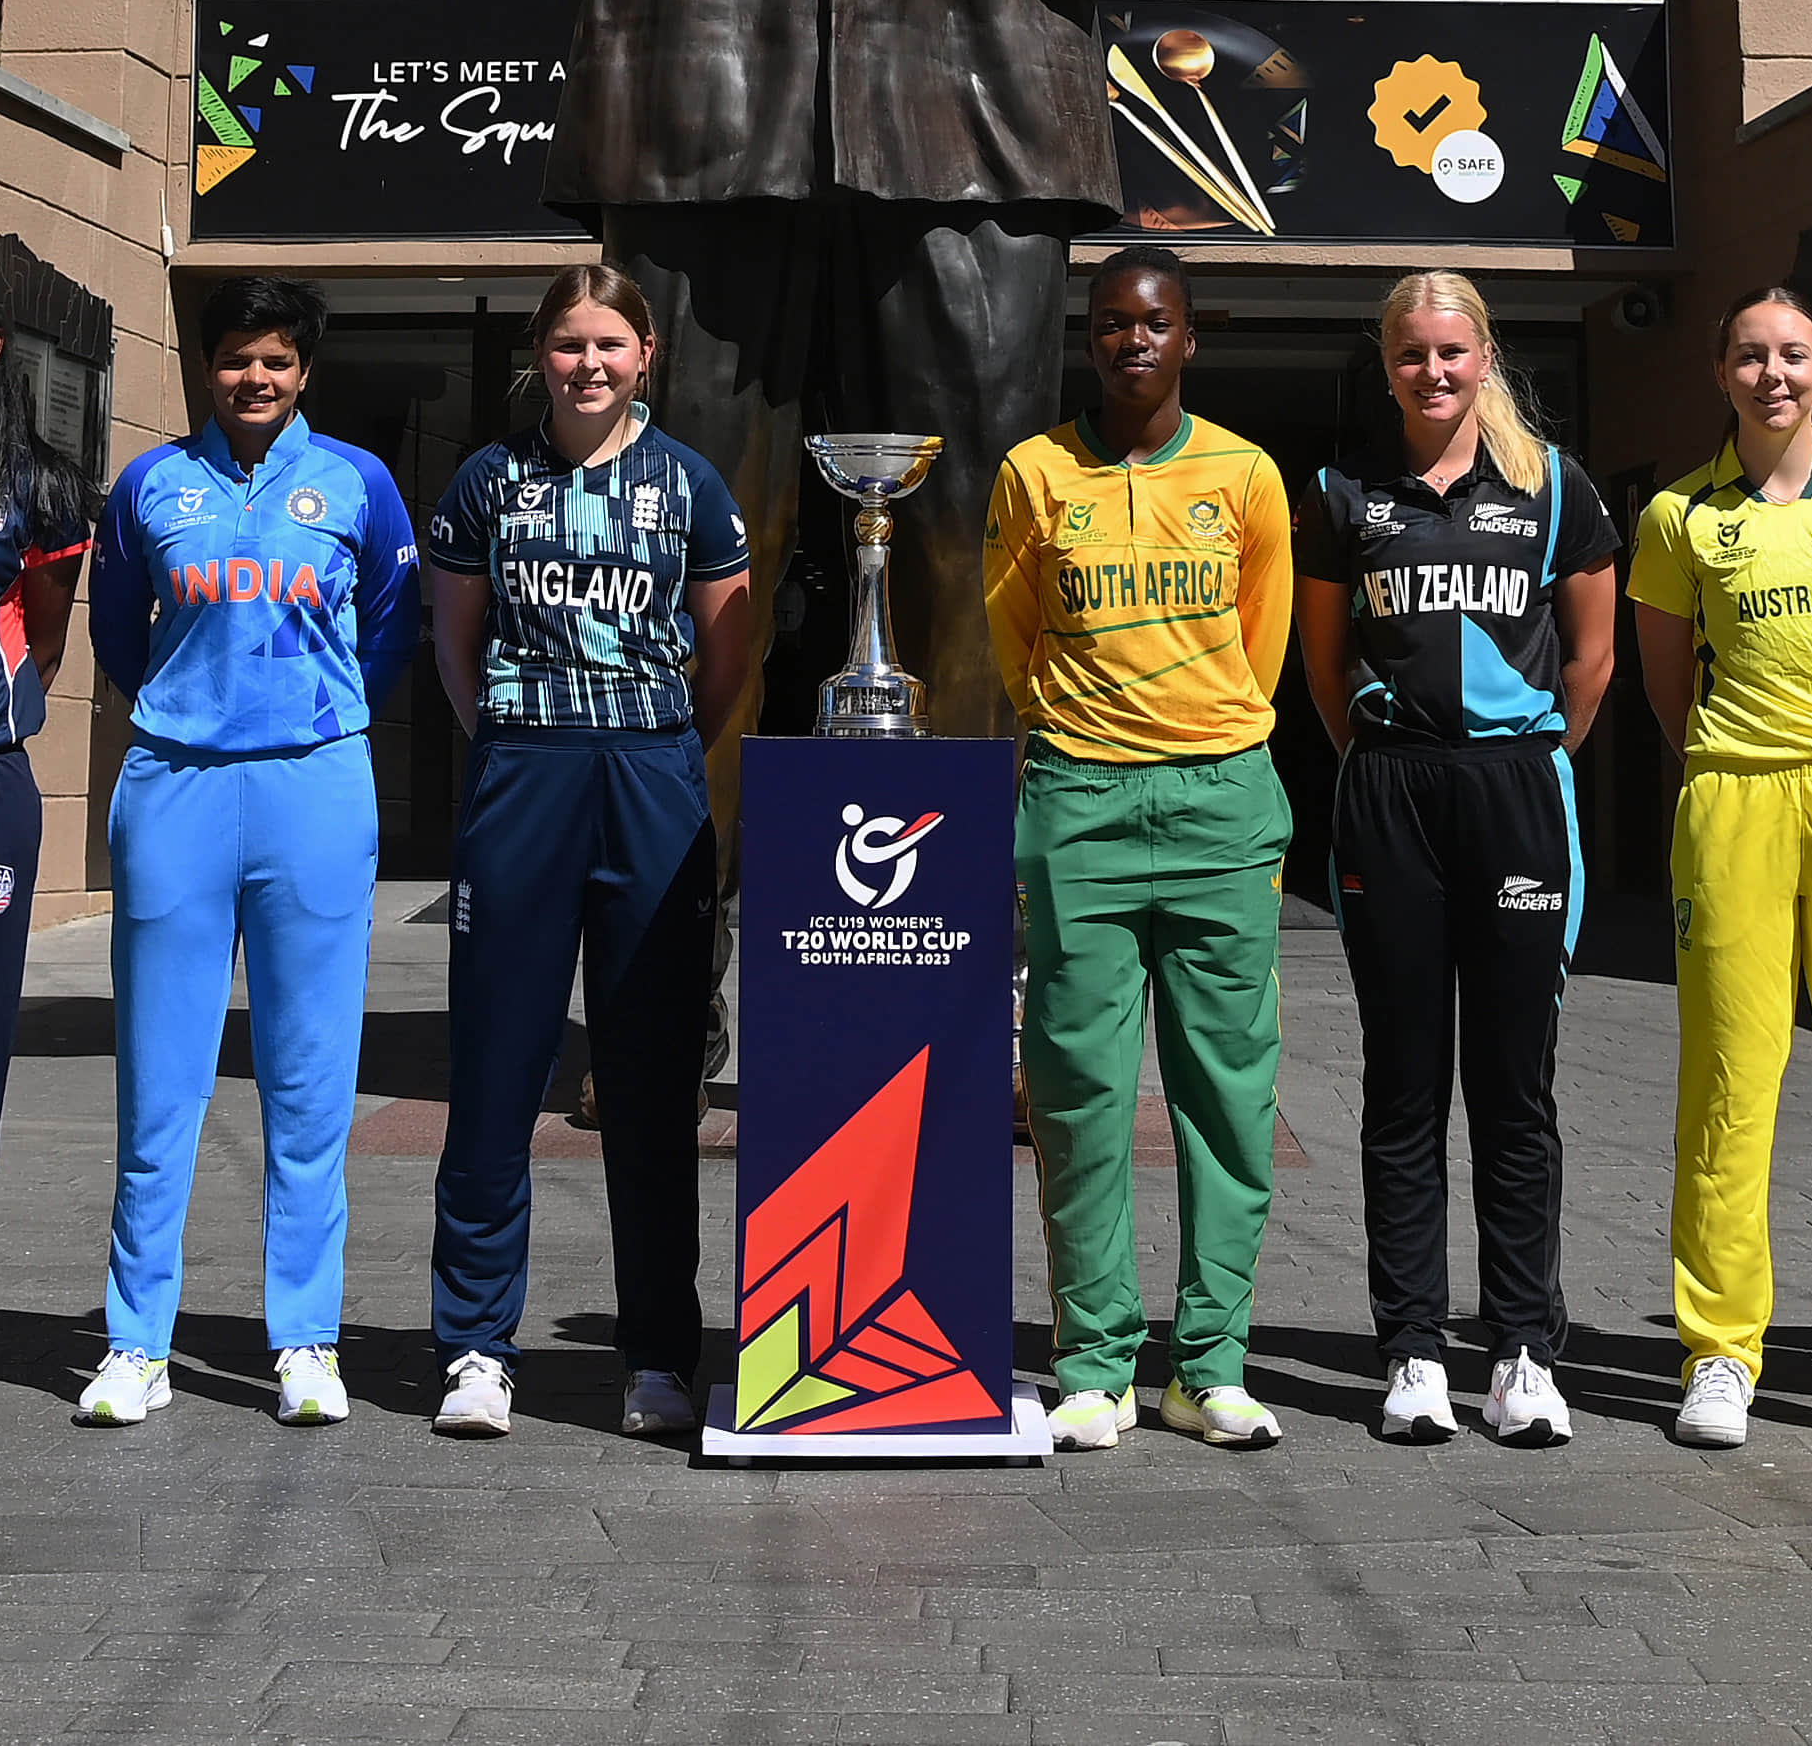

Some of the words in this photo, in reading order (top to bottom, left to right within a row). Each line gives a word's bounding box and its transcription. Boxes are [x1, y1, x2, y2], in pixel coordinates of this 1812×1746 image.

[373, 60, 449, 83] LET'S
[459, 60, 539, 83] MEET
[548, 60, 567, 82] A
[331, 88, 425, 151] The
[440, 85, 556, 165] Squ
[1457, 158, 1496, 171] SAFE
[1469, 519, 1521, 535] UNDER
[1522, 523, 1538, 538] 19
[169, 556, 323, 610] INDIA
[501, 559, 654, 614] ENGLAND
[1058, 563, 1137, 615] SOUTH
[1144, 559, 1224, 607] AFRICA
[1363, 566, 1411, 619] NEW
[1416, 564, 1530, 618] ZEALAND
[1497, 896, 1550, 911] UNDER
[1549, 897, 1563, 911] 19
[809, 916, 835, 929] ICC
[838, 916, 865, 929] U19
[869, 916, 944, 929] WOMEN'S
[781, 930, 825, 950] T20
[829, 930, 918, 951] WORLD
[922, 931, 971, 951] CUP
[800, 952, 853, 965] SOUTH
[856, 952, 913, 965] AFRICA
[915, 952, 951, 966] 2023
